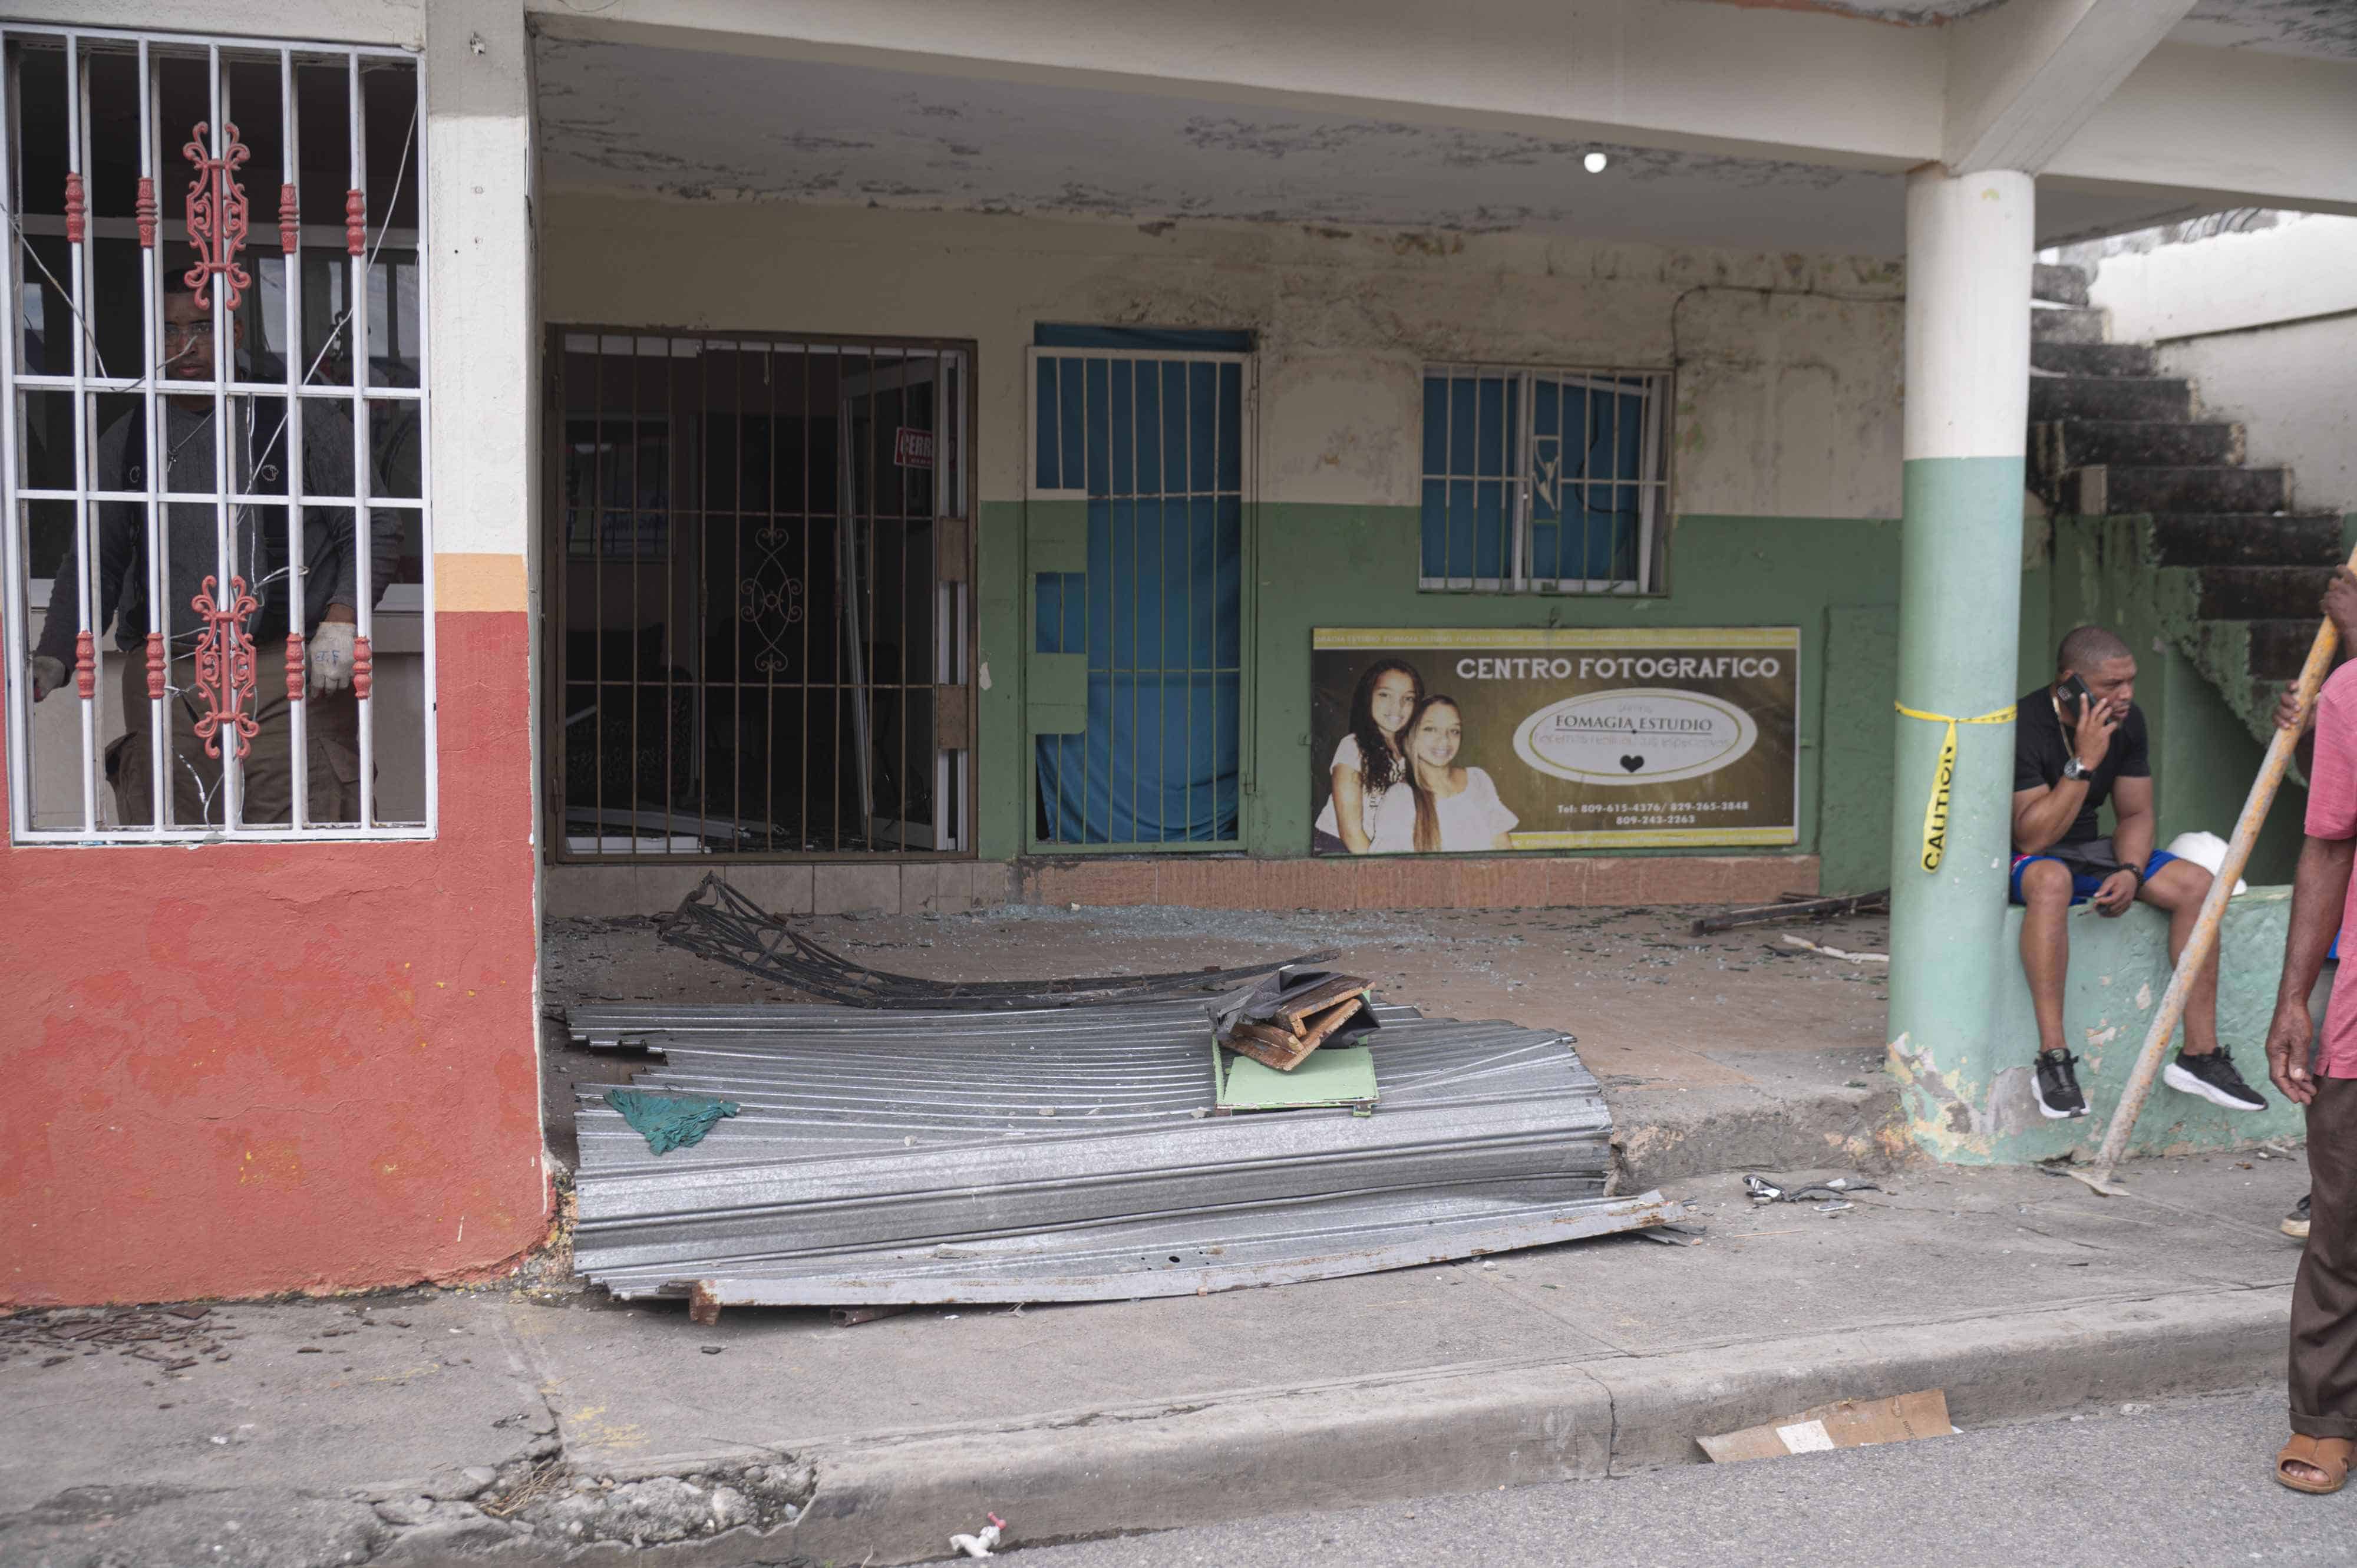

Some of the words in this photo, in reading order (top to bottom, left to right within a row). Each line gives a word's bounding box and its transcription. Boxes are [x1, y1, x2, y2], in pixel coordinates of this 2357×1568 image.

[1455, 657, 1572, 679] CENTRO
[1579, 656, 1780, 679] FOTOGRAFICO
[1556, 715, 1633, 729] FOMAGIA
[1639, 717, 1713, 731] ESTUDIO
